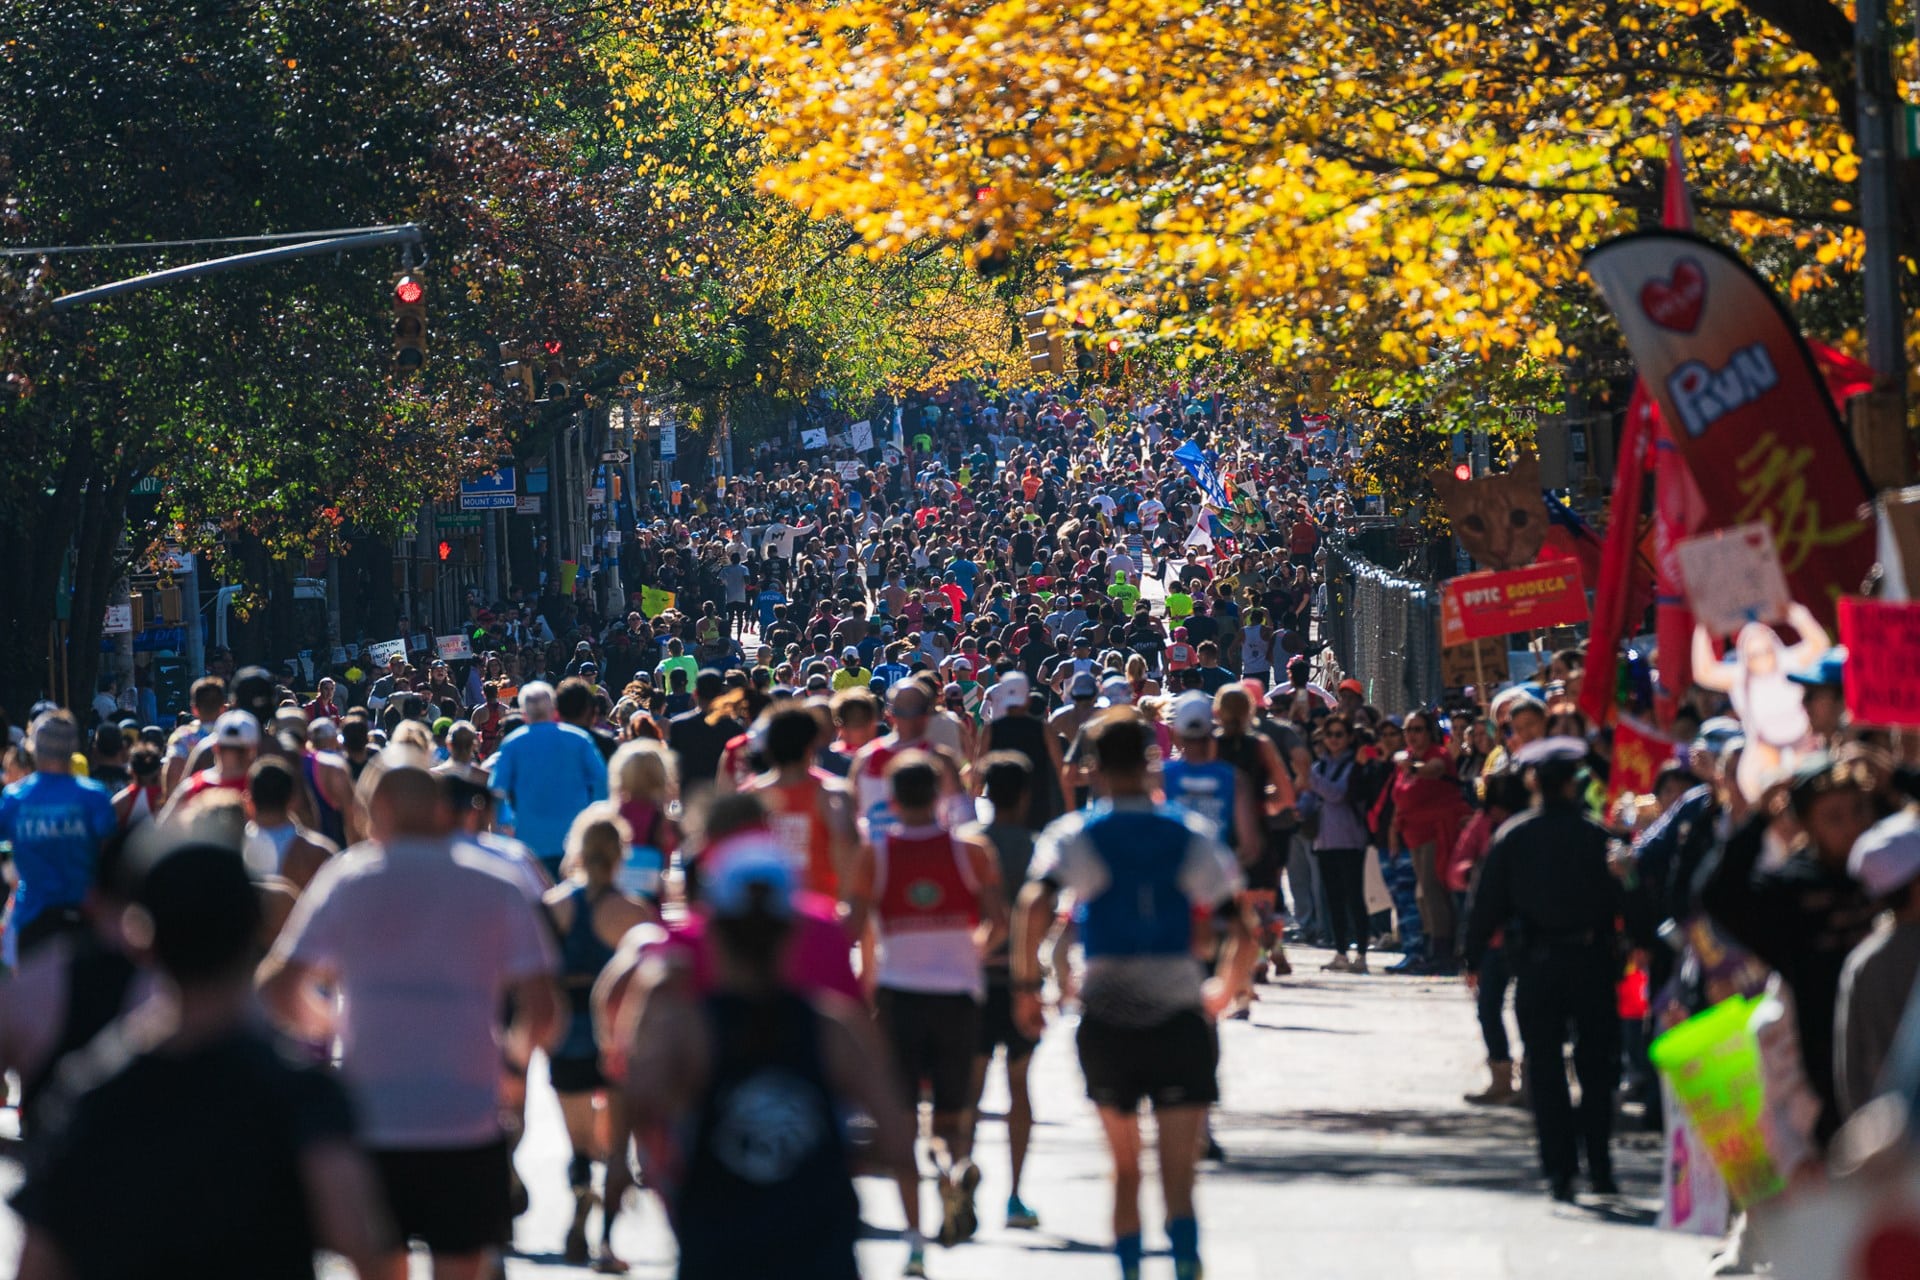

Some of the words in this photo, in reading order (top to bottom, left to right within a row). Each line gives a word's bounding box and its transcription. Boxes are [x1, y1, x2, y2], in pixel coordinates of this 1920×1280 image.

[1668, 341, 1778, 438] RUN
[1527, 409, 1537, 422] St
[140, 477, 157, 491] 107
[463, 498, 490, 506] MOUNT
[493, 497, 514, 505] SINAI
[1505, 575, 1567, 600] BODEGA
[888, 670, 903, 686] 10
[16, 819, 87, 838] ITALIA
